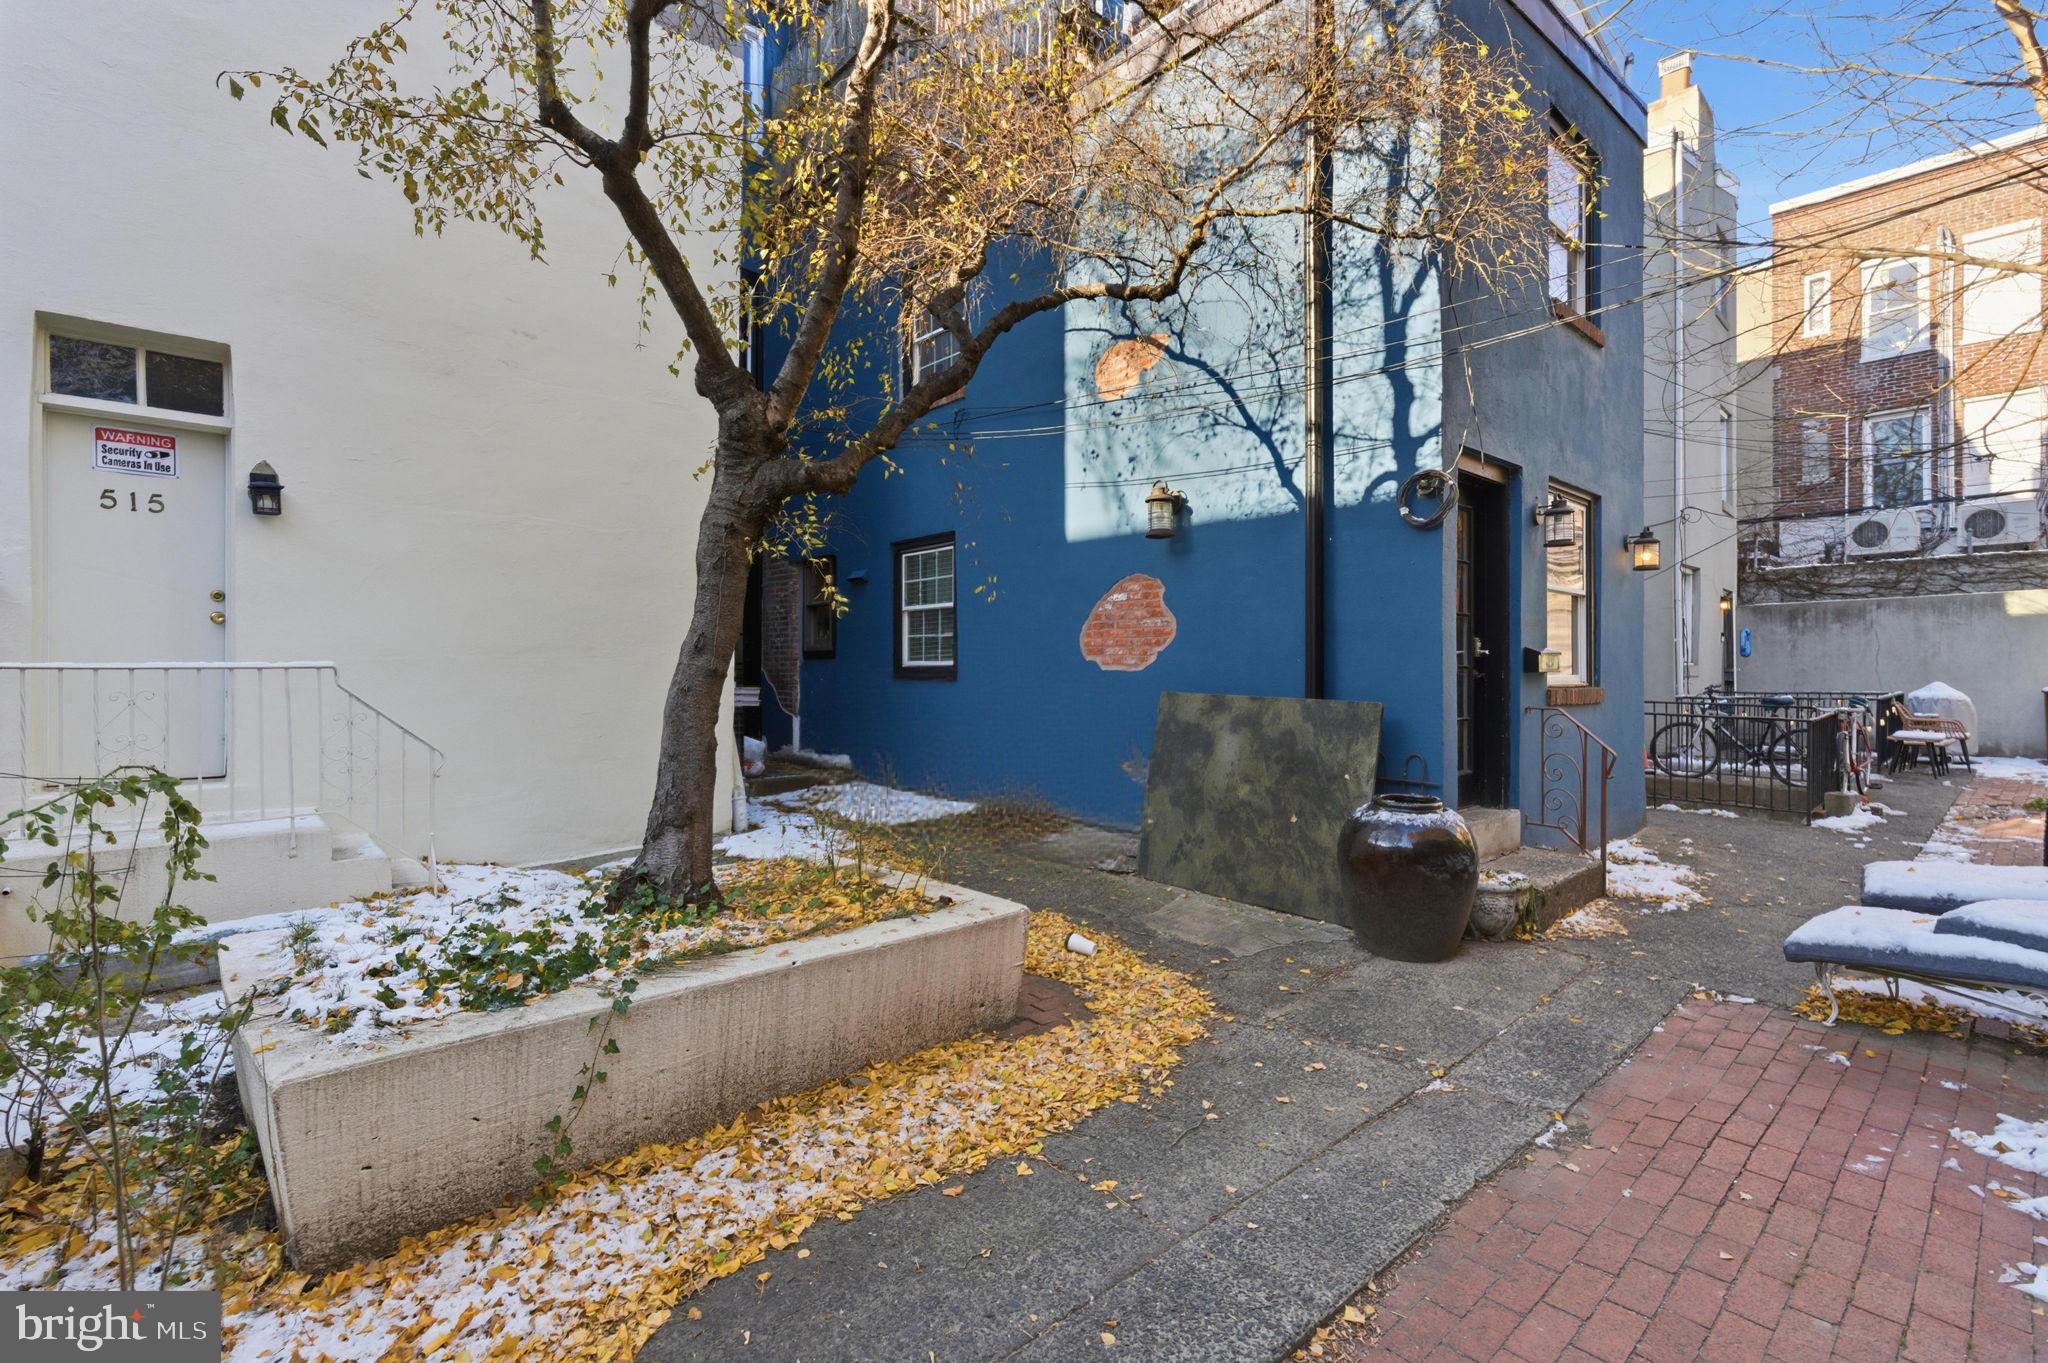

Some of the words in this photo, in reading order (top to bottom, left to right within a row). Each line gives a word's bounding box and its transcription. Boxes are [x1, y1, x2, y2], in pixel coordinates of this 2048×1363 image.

[100, 430, 172, 448] WARNING
[101, 444, 142, 459] Security
[102, 456, 142, 470] Cameras
[143, 461, 153, 470] In
[154, 462, 171, 473] Use
[100, 489, 165, 513] 515
